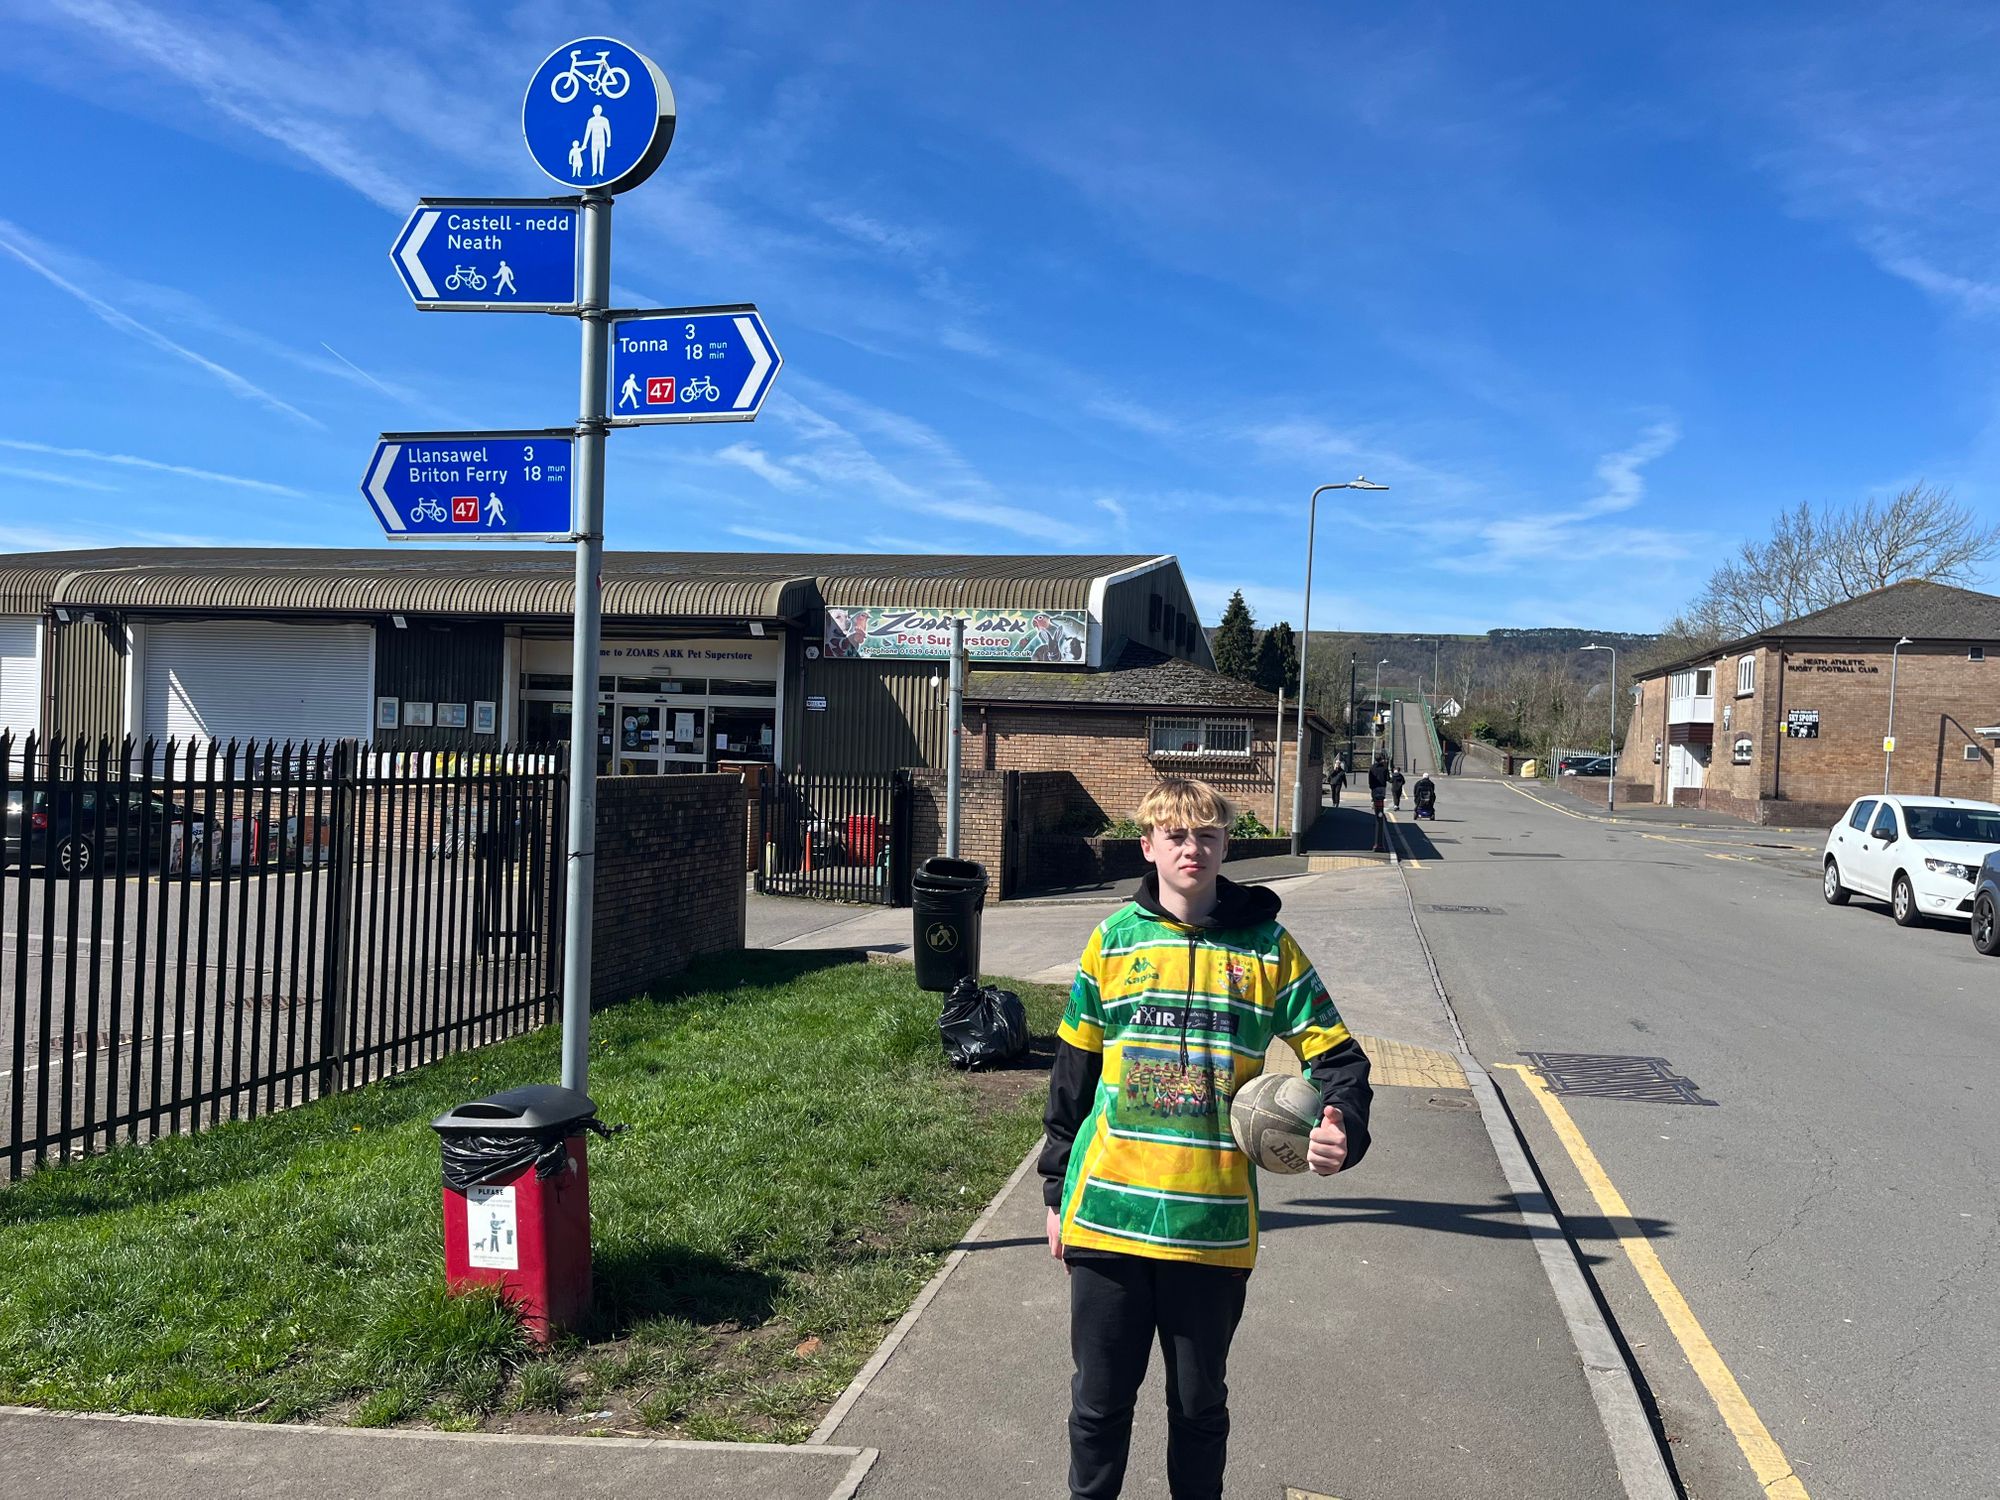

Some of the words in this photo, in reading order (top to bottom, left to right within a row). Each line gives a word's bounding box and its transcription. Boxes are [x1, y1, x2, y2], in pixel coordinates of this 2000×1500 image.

[447, 214, 512, 231] Castell
[525, 215, 569, 231] nedd
[448, 234, 502, 250] Neath
[685, 323, 696, 340] 3
[619, 337, 668, 353] Tonna
[709, 341, 728, 350] mun
[685, 343, 703, 361] 18
[709, 350, 725, 360] min
[649, 382, 672, 399] 47
[408, 447, 488, 463] Llansawel
[523, 445, 534, 462] 3
[409, 467, 460, 483] Briton
[466, 467, 508, 485] Ferry
[523, 465, 542, 482] 18
[547, 464, 566, 473] mun
[547, 474, 563, 482] min
[455, 502, 476, 517] 47
[897, 634, 924, 645] Pet
[927, 634, 1010, 647] Surstore
[614, 648, 623, 656] to
[625, 648, 660, 658] ZOARS
[662, 649, 684, 658] ARK
[687, 649, 702, 659] Pet
[705, 650, 753, 660] Superstore
[863, 647, 898, 655] Telephone
[1816, 665, 1856, 673] FOOTBALL
[1789, 714, 1799, 722] SKY
[1799, 714, 1818, 722] SPORTS
[1124, 972, 1160, 986] Kappa
[477, 1188, 504, 1196] PLEASE
